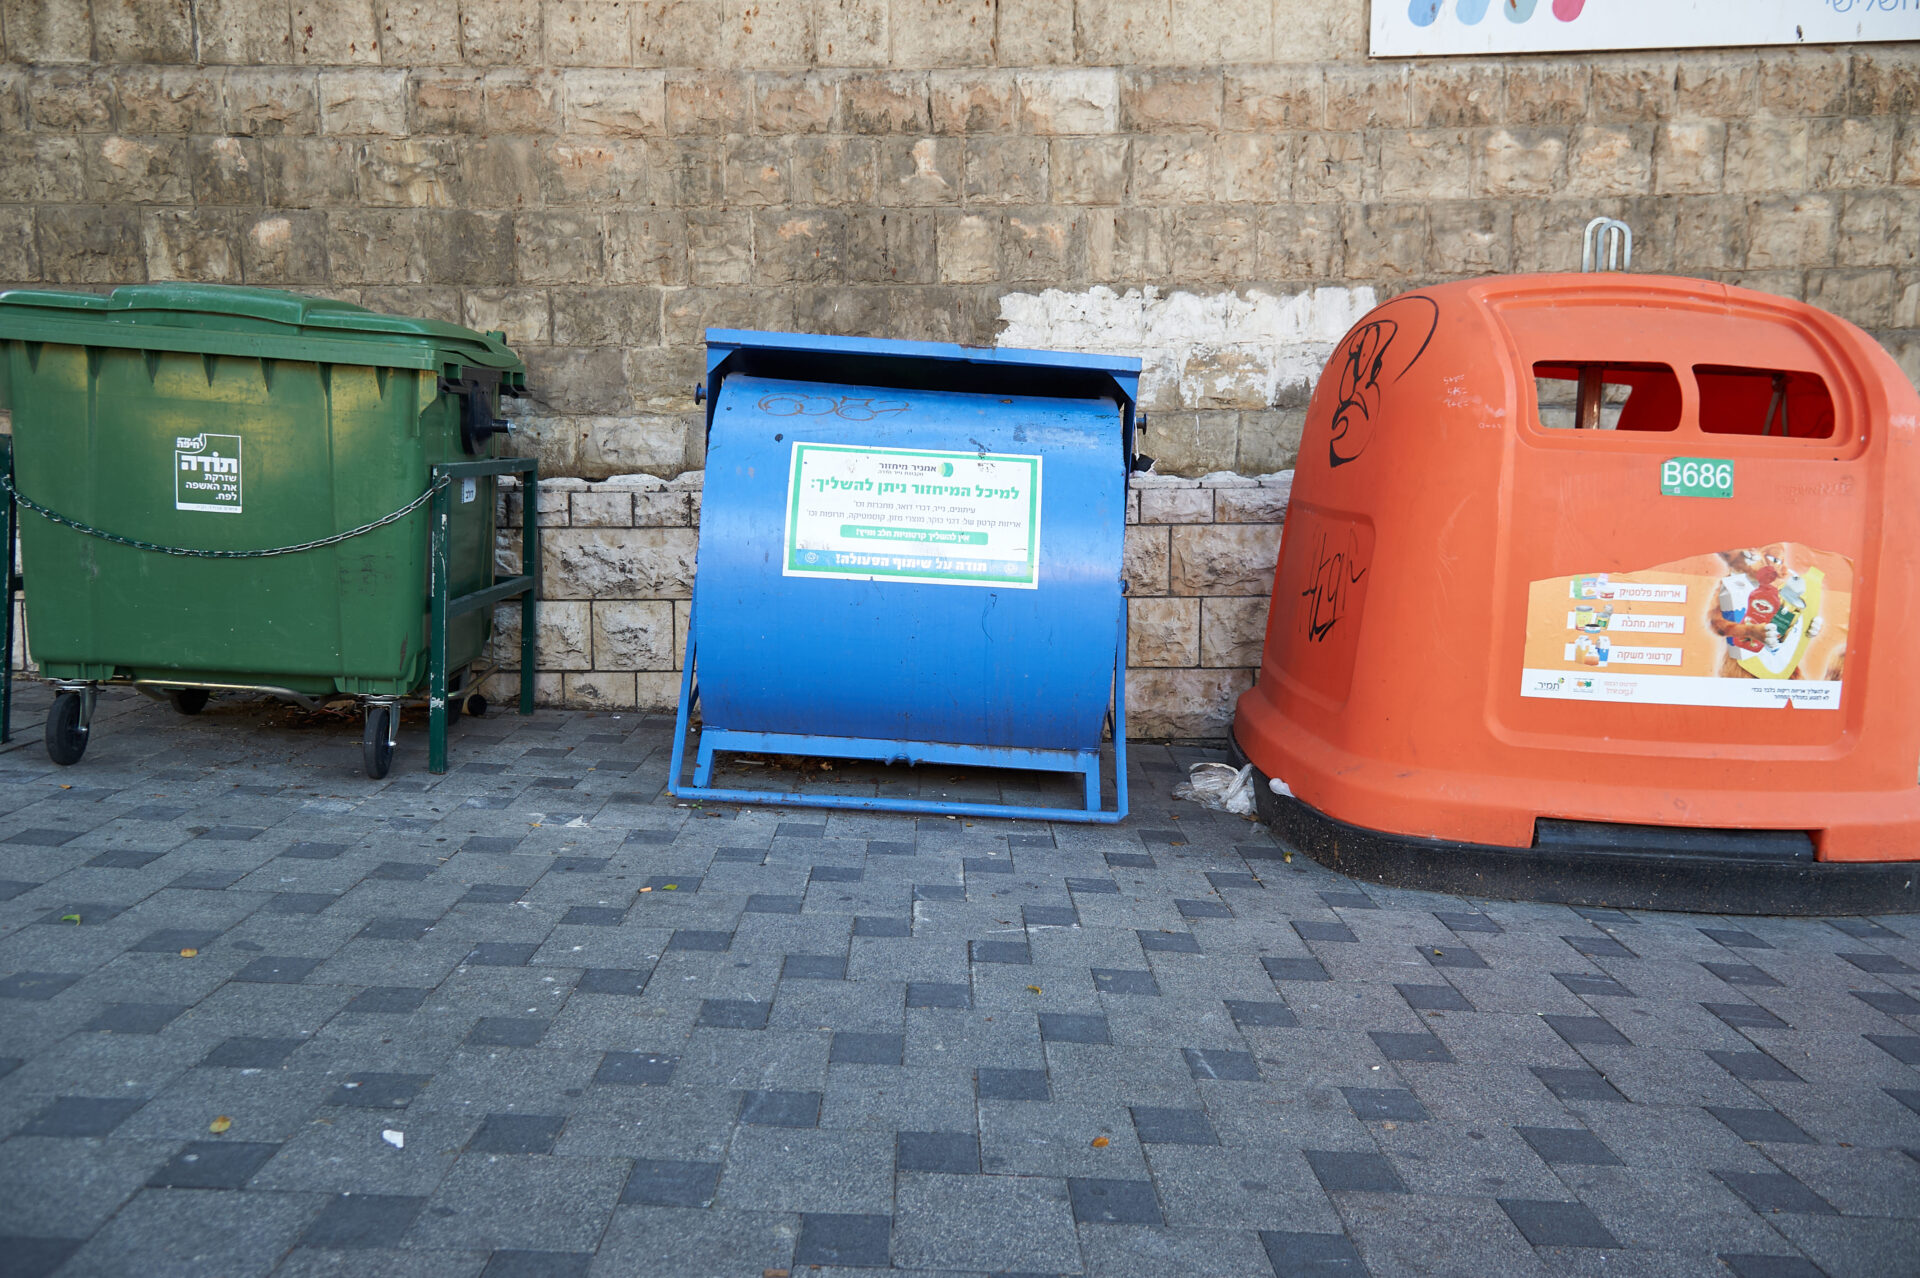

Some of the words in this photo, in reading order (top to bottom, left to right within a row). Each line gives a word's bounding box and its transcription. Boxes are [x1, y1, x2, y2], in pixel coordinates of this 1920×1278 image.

[181, 451, 238, 473] תודה
[878, 462, 908, 470] מיחזור
[911, 464, 937, 472] אמניר
[204, 473, 237, 482] שזרקת
[1664, 461, 1732, 489] B686
[185, 481, 220, 490] האשפה
[222, 483, 237, 492] את
[811, 476, 874, 493] להשליך:
[878, 481, 907, 496] ניתן
[911, 483, 971, 497] המיחזור
[975, 484, 1020, 500] למיכל
[215, 492, 237, 501] לפח.
[866, 501, 894, 510] מחברות
[896, 503, 913, 511] דואר,
[915, 503, 931, 512] דברי
[932, 504, 946, 513] נייר,
[947, 504, 976, 514] עיתונים,
[819, 510, 845, 519] תרופות
[846, 512, 886, 523] קוסמטיקה,
[888, 513, 903, 523] מזון,
[905, 514, 925, 523] מוצרי
[946, 516, 960, 525] דגני
[976, 518, 997, 528] קרטון
[998, 520, 1022, 528] אריזות
[877, 528, 892, 537] חלב
[928, 531, 957, 542] להשליך
[836, 552, 889, 567] הפעולה!
[893, 555, 933, 571] שיתוף
[935, 557, 953, 570] על
[955, 561, 987, 572] תודה
[1620, 588, 1653, 598] פלסטיק
[1654, 589, 1681, 598] אריזות
[1621, 619, 1646, 628] מתכת
[1648, 621, 1675, 629] אריזות
[1617, 650, 1644, 660] משקה
[1646, 653, 1673, 662] קרטוני
[1537, 681, 1560, 690] תמיר
